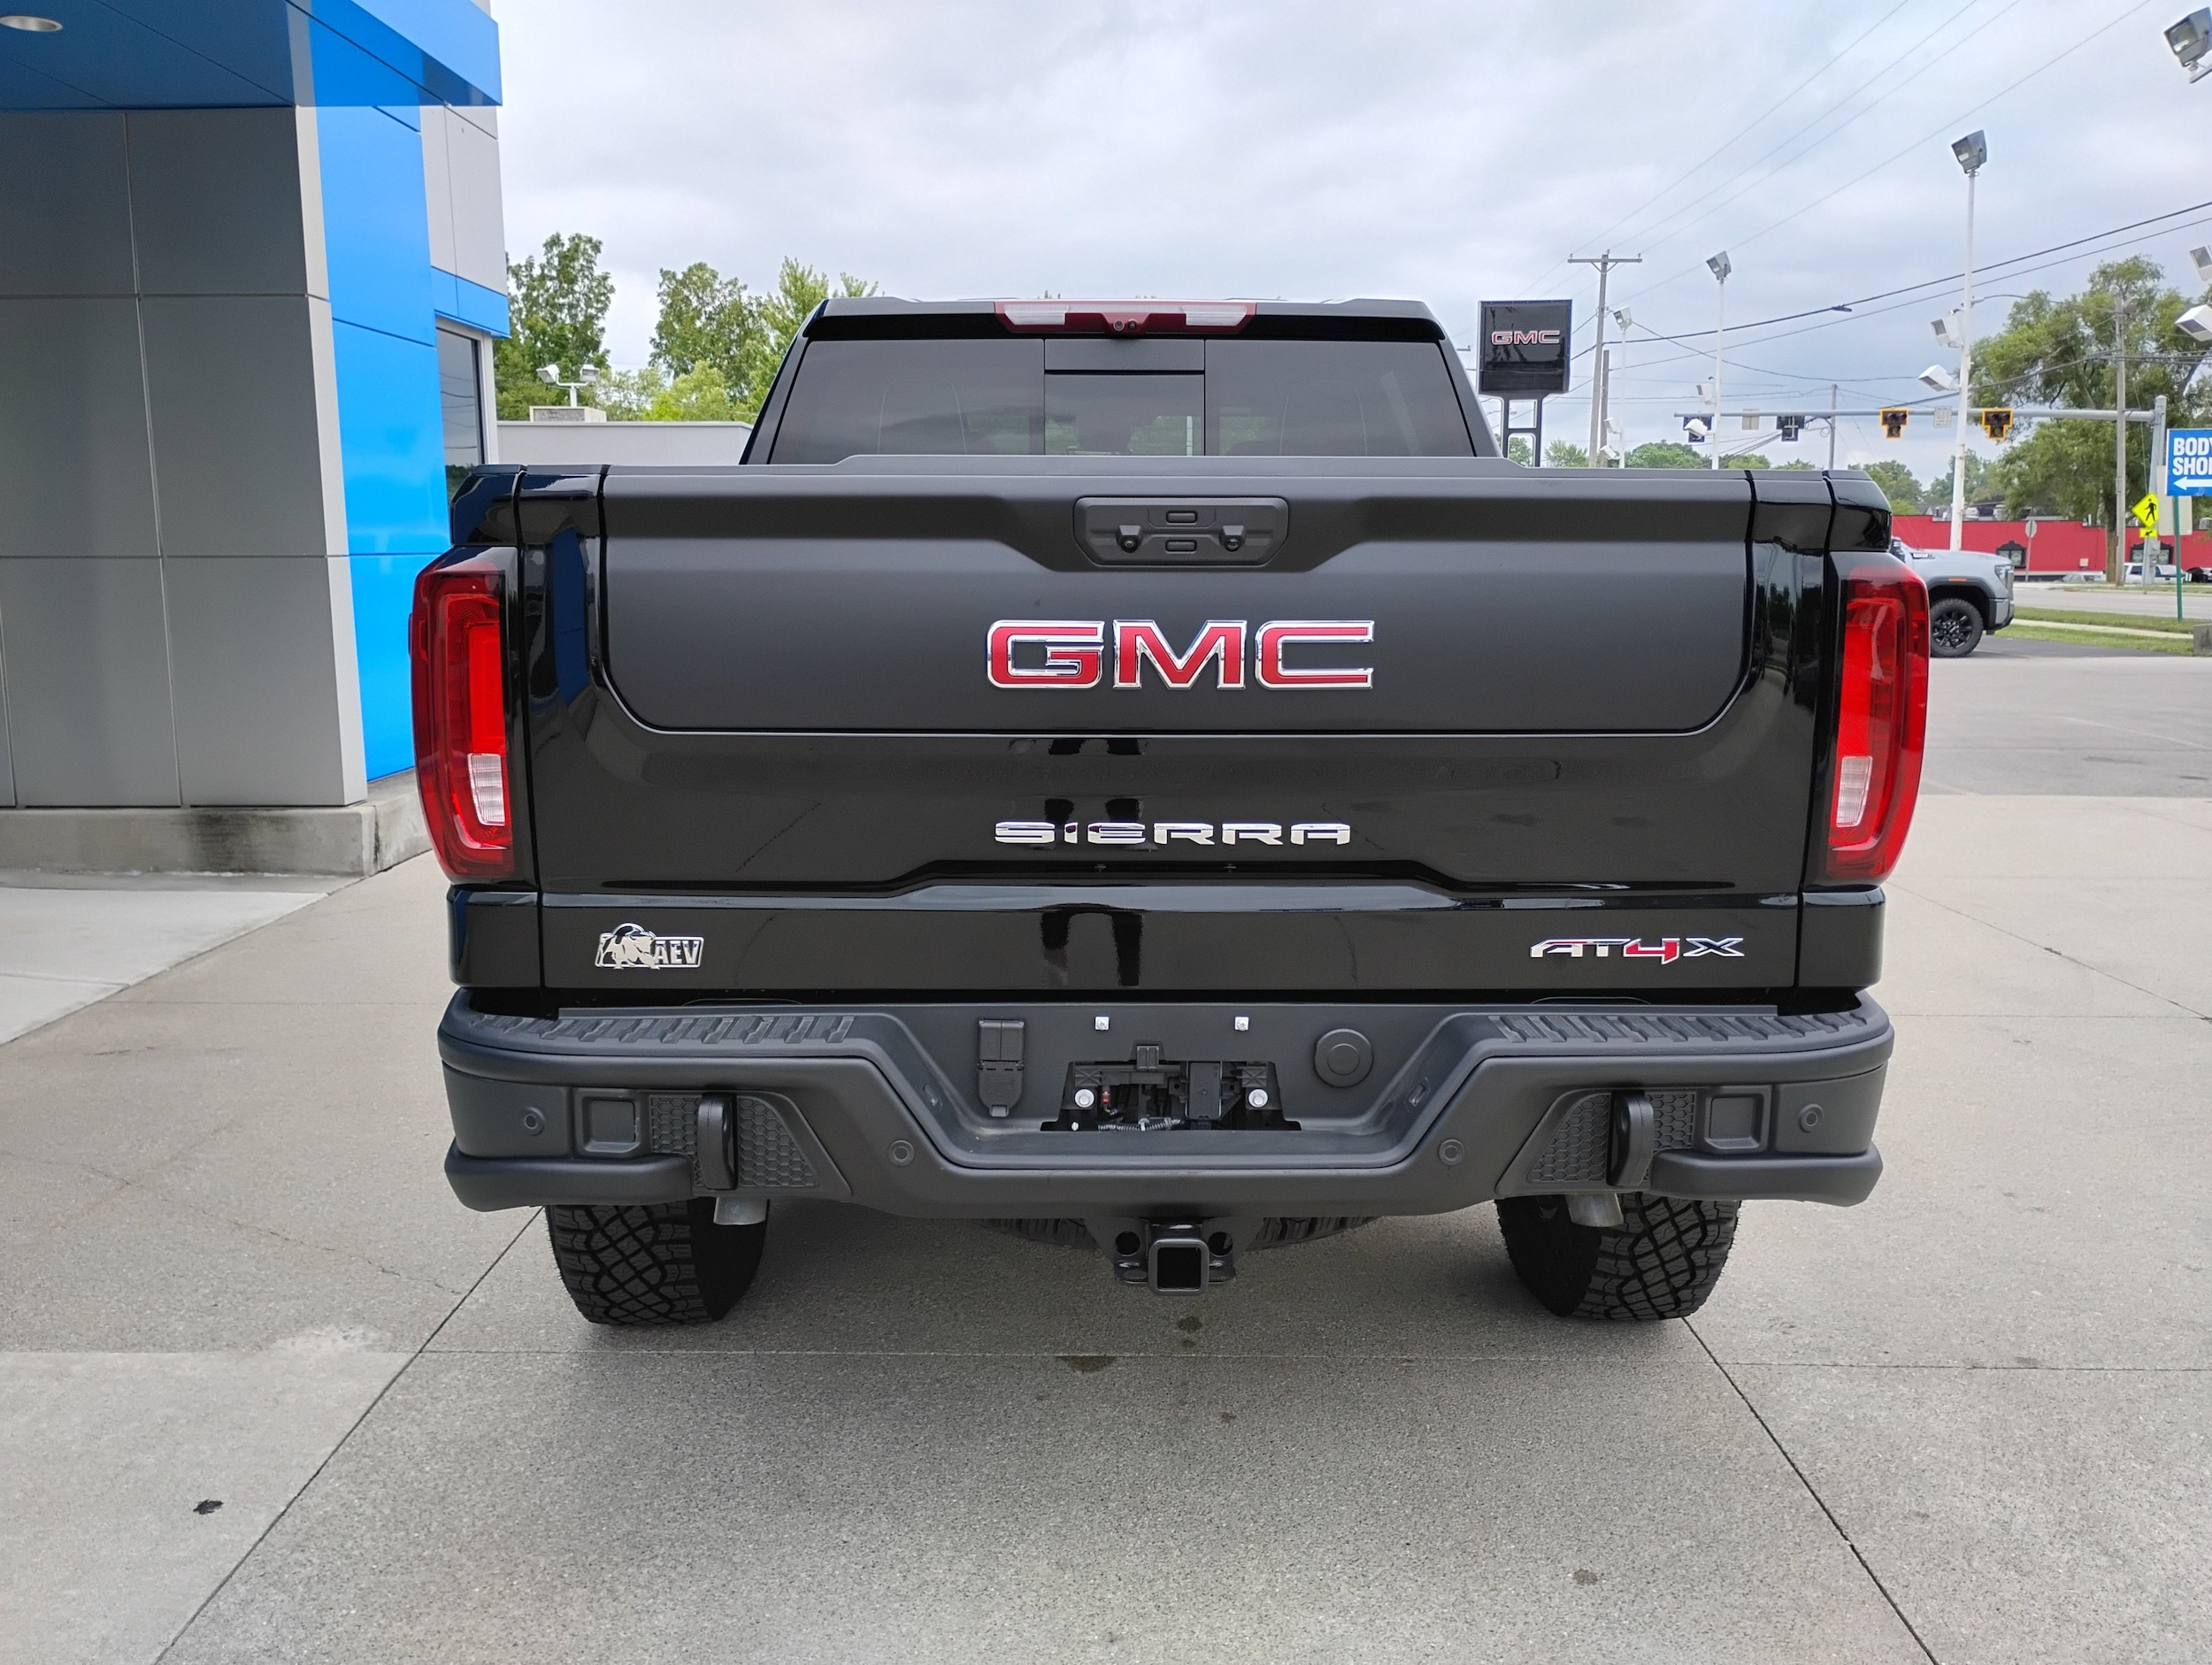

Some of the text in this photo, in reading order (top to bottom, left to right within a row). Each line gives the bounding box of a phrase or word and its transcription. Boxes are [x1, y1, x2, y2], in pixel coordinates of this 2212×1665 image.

[1492, 330, 1560, 345] GMC
[2172, 457, 2212, 476] SHO
[987, 619, 1375, 689] GMC
[995, 822, 1350, 846] SIERRA
[655, 940, 700, 964] AEV
[1530, 938, 1745, 964] AT4X
